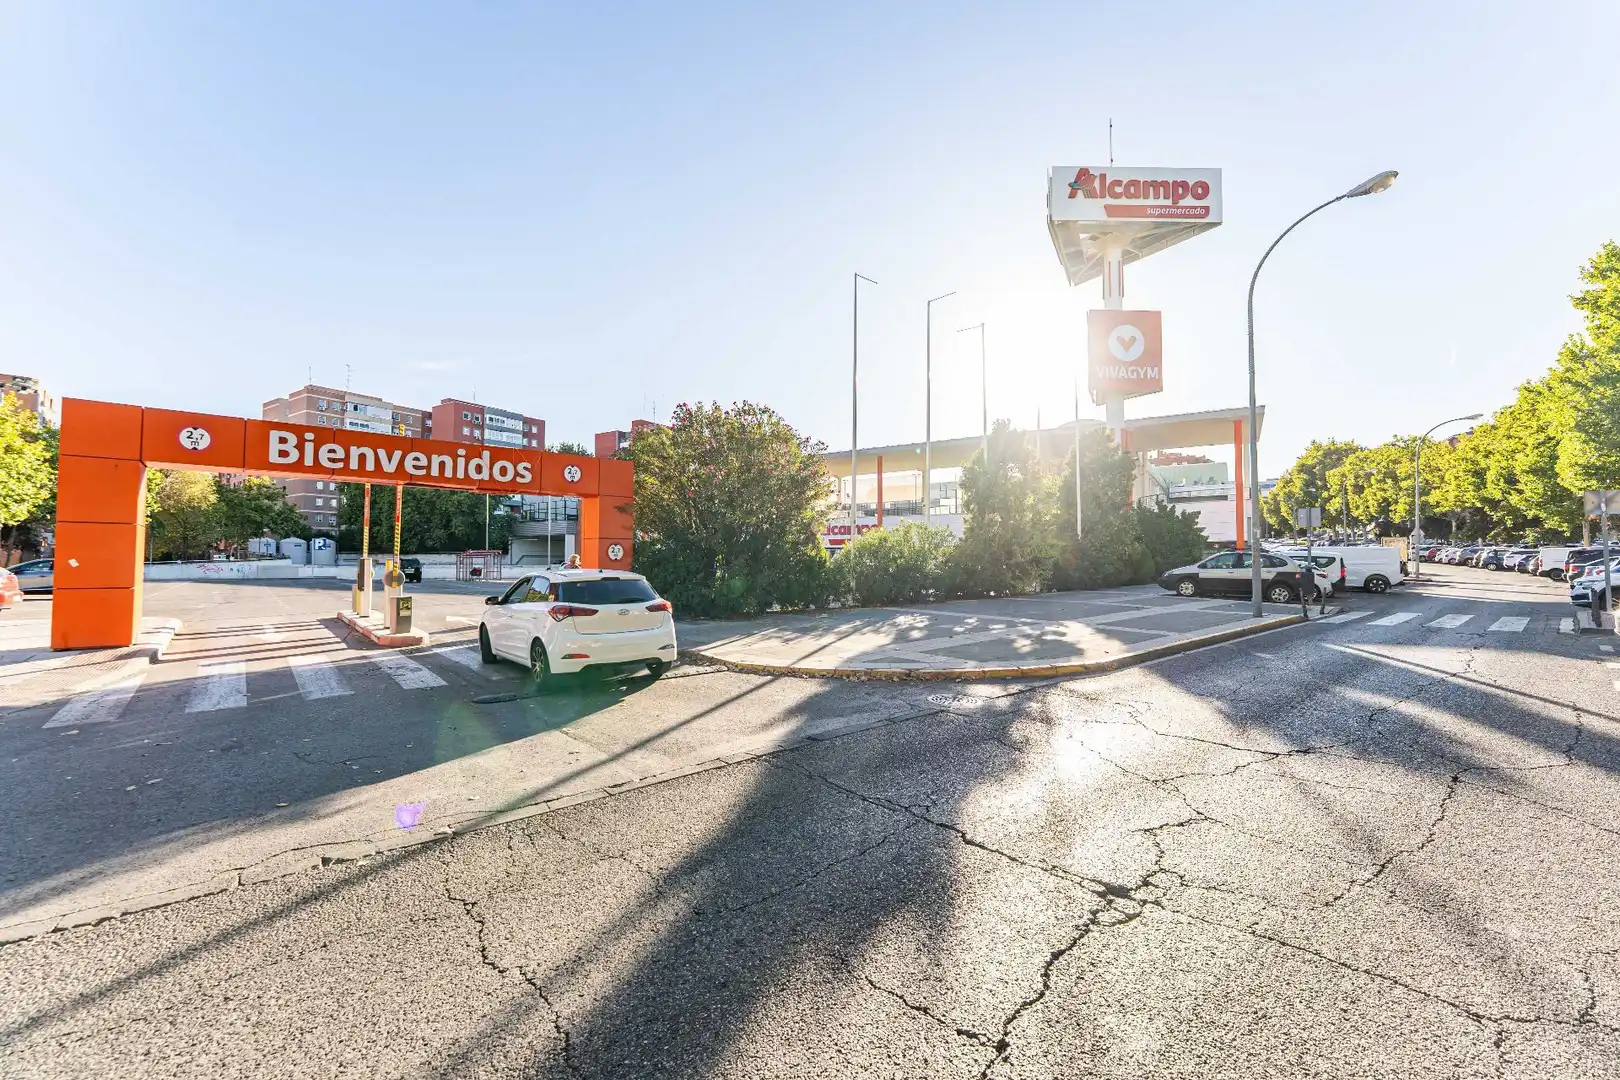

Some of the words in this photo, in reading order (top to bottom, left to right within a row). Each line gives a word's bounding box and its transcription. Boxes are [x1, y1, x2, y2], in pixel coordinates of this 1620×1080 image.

[1067, 168, 1210, 205] Alcampo
[1146, 206, 1206, 215] supermercado
[1095, 365, 1159, 379] VIVAGYM
[268, 430, 533, 484] Bienvenidos
